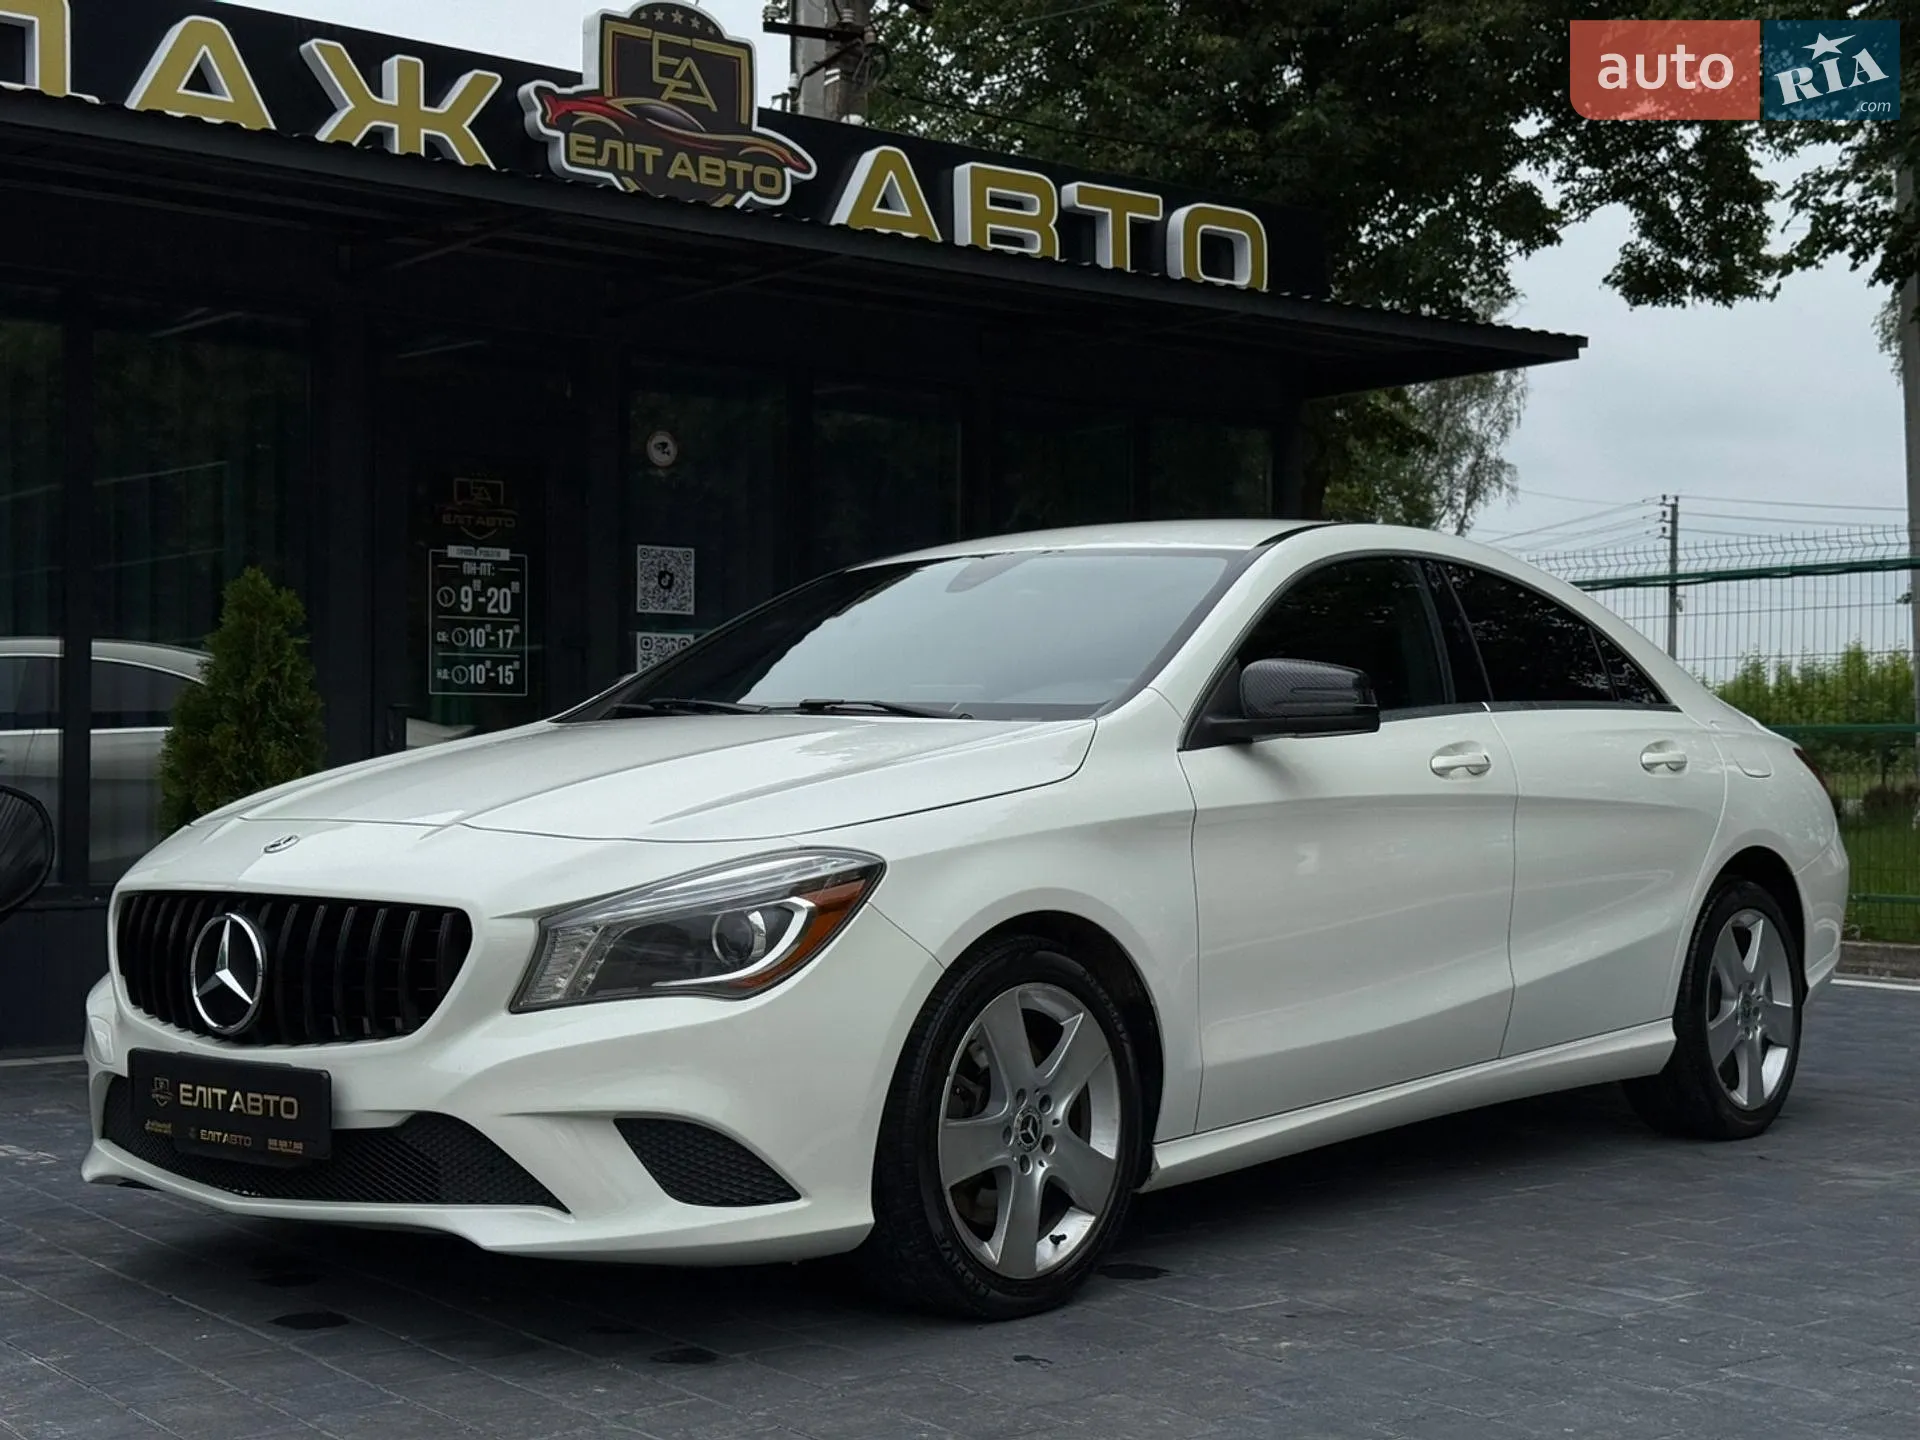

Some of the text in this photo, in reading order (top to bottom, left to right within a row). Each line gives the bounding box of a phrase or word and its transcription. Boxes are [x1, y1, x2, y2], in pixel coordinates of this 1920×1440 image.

[568, 132, 785, 197] ЕЛІТ АВТО
[829, 145, 1268, 292] АВТО
[475, 516, 517, 529] АВТО
[179, 1083, 299, 1121] ЕЛІТ АВТО
[222, 1131, 253, 1148] АВТО
